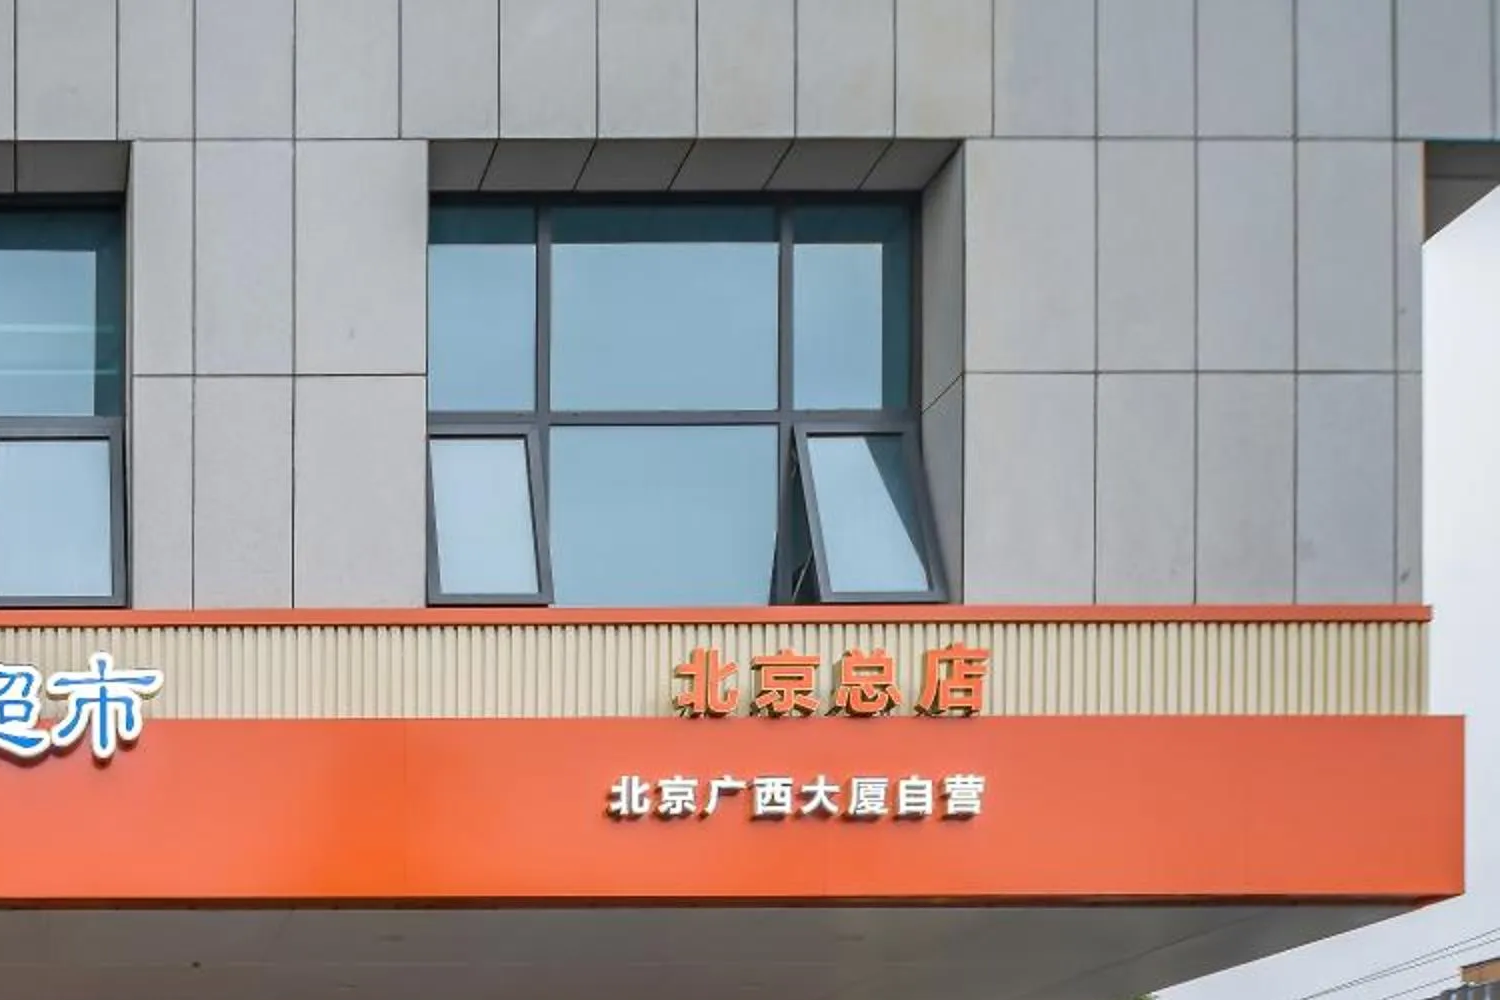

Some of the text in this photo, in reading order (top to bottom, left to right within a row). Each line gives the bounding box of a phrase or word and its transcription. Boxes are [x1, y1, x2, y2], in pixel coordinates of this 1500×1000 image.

[674, 641, 992, 716] 北京总店
[609, 774, 987, 816] 北京广西大厦自营
